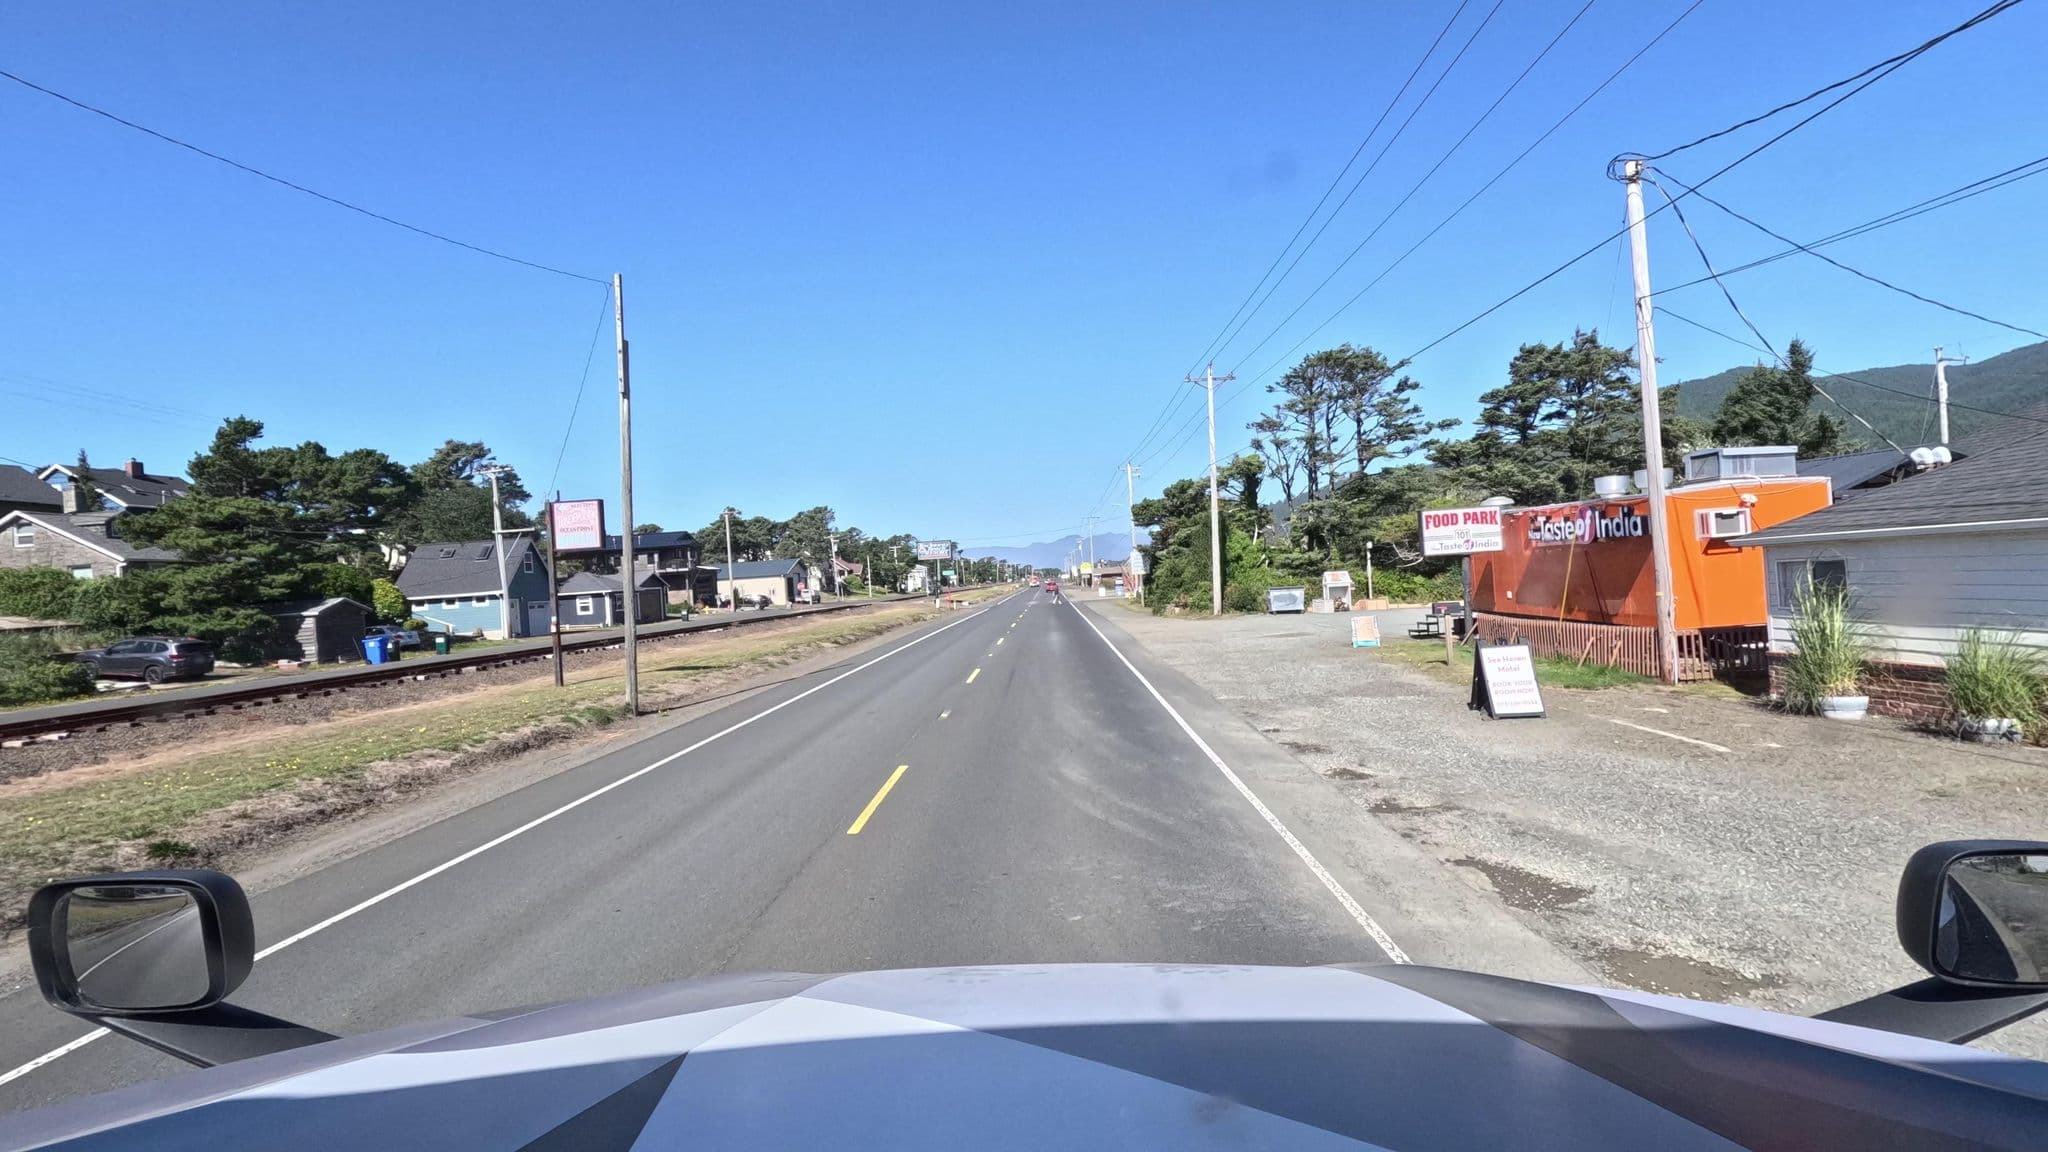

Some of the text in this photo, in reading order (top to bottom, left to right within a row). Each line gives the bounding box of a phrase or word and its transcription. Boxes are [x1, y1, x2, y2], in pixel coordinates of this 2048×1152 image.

[1425, 510, 1498, 530] FOOD PARK
[1537, 516, 1575, 540] Taste
[1575, 510, 1592, 542] of
[1595, 507, 1642, 538] India
[1456, 531, 1469, 539] 101
[1440, 541, 1462, 551] Taste
[1475, 539, 1499, 548] India
